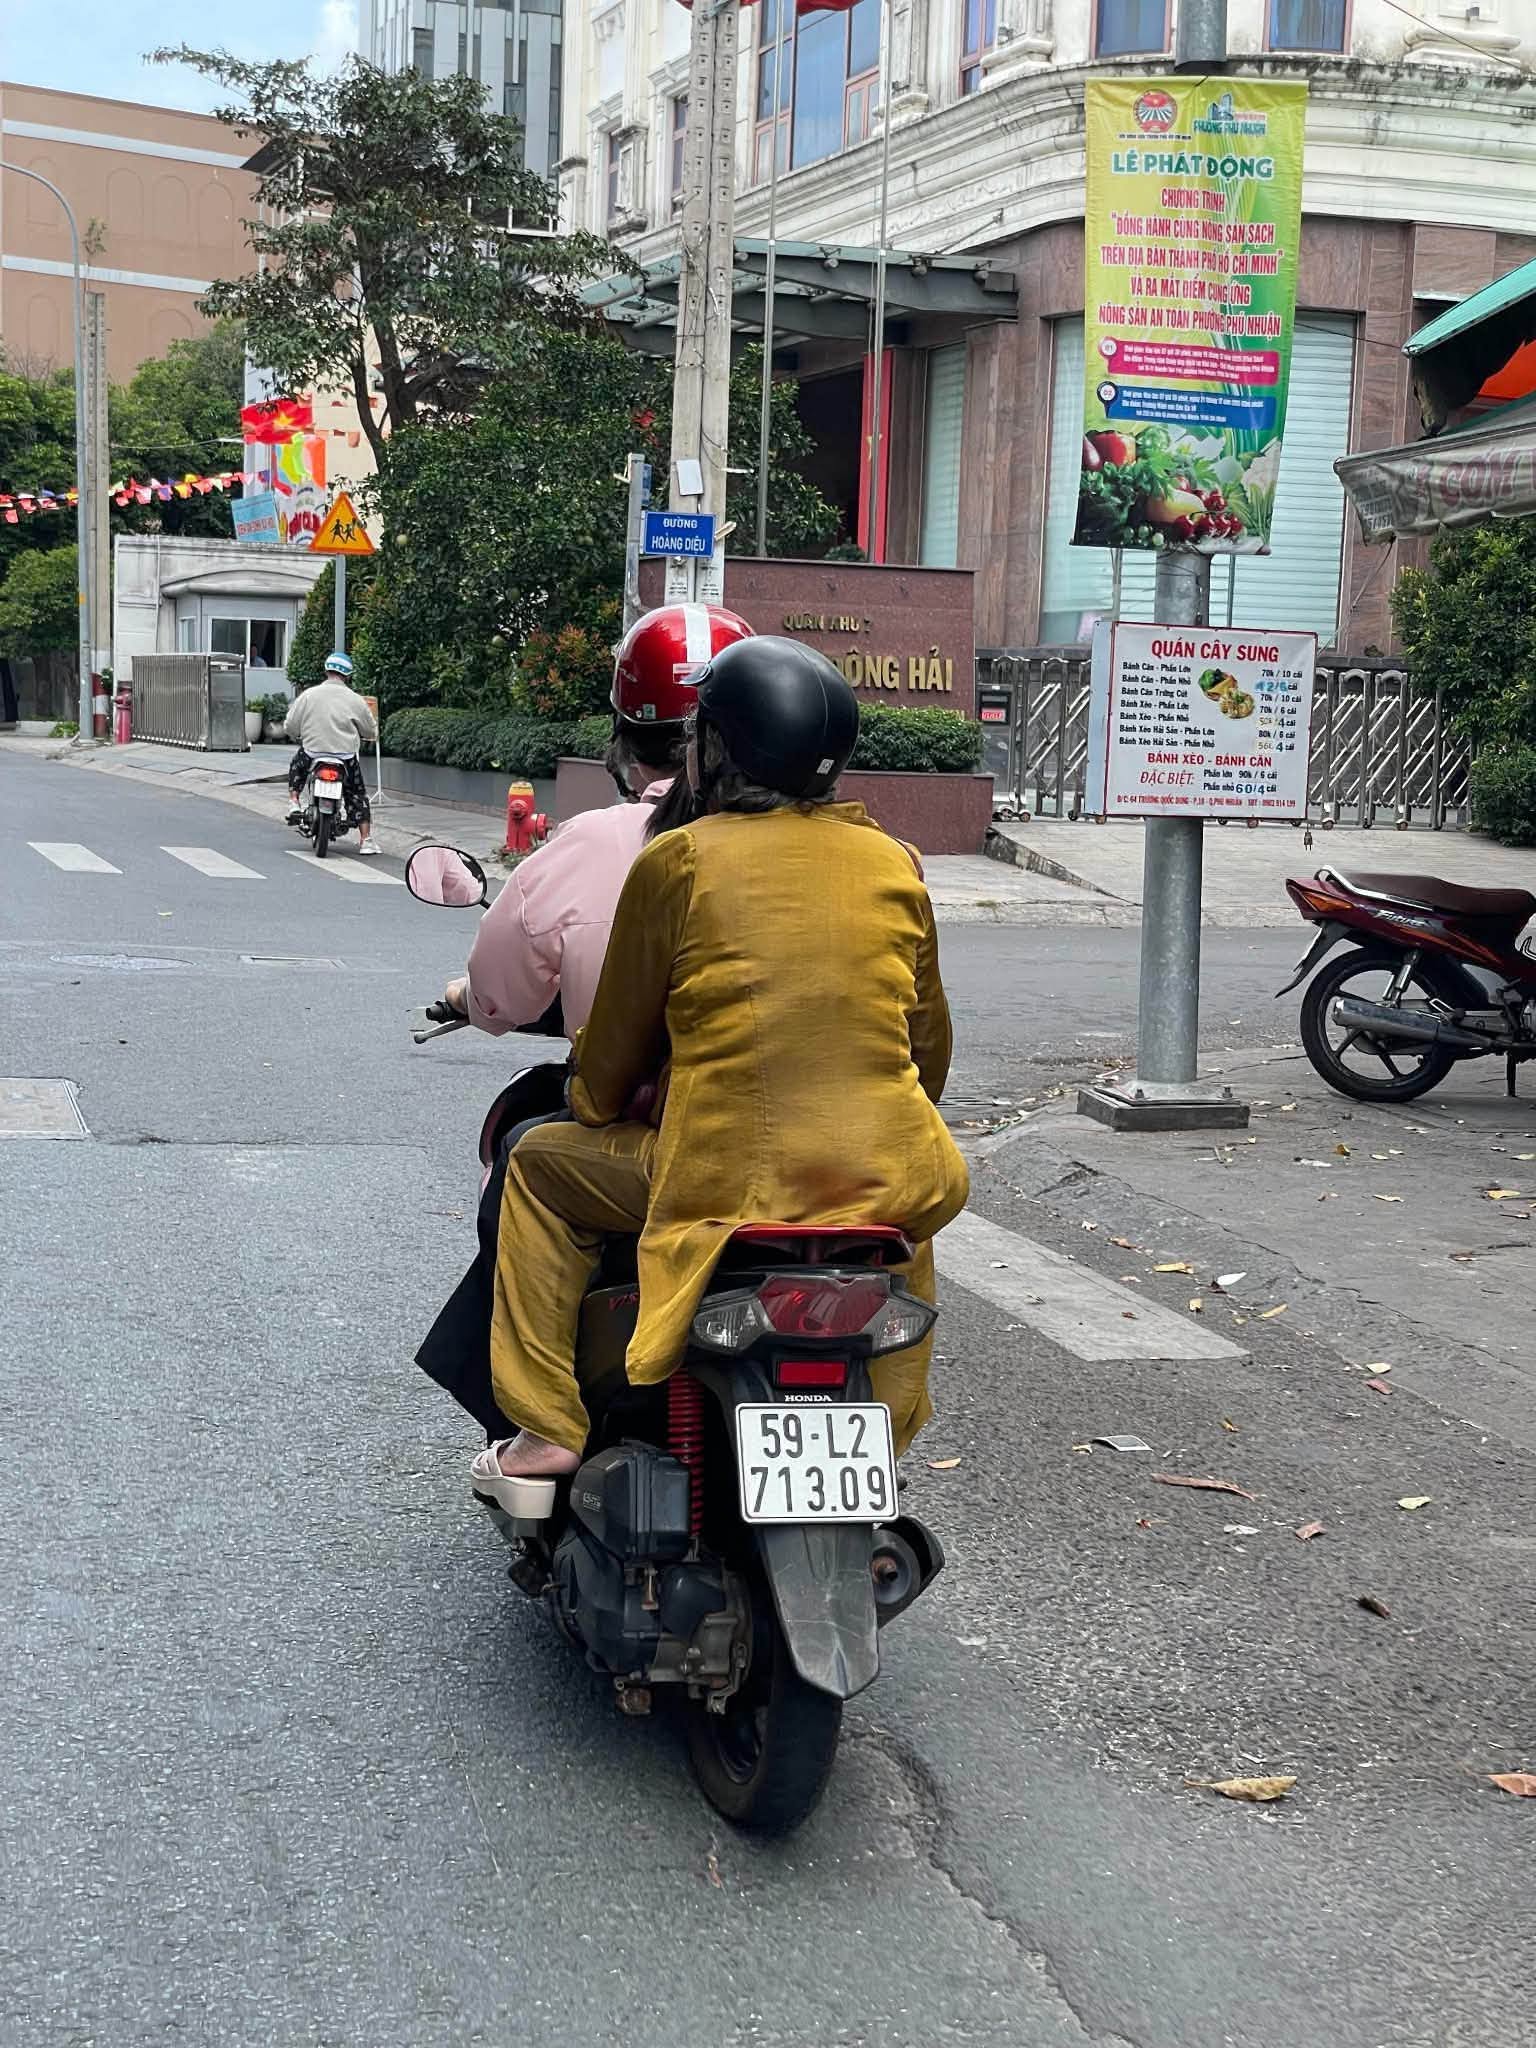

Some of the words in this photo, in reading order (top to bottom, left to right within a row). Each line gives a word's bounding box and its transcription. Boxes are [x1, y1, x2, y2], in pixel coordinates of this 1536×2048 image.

[1144, 152, 1203, 174] PHÁT
[1207, 155, 1273, 181] ĐỘNG
[1162, 187, 1199, 208] CHƯƠNG
[1146, 213, 1171, 237] HÀNH
[1174, 215, 1199, 239] CÙNG
[1248, 223, 1274, 248] SẠCH
[1101, 242, 1126, 265] TRÊN
[1128, 246, 1144, 269] ĐỊA
[1147, 244, 1166, 267] BÀN
[1169, 246, 1199, 269] THÀNH
[1131, 272, 1143, 295] VÀ
[1146, 277, 1158, 297] RA
[1161, 271, 1180, 298] MẮT
[1183, 272, 1206, 300] ĐIỂM
[1208, 281, 1228, 303] CUNG
[1230, 281, 1250, 304] ỨNG
[1099, 301, 1126, 325] NÔNG
[1128, 300, 1148, 326] SẢN
[1150, 308, 1163, 327] AN
[1166, 305, 1190, 328] TOÀN
[1193, 308, 1225, 333] PHƯỜNG
[1226, 312, 1246, 335] PHÚ
[1247, 311, 1281, 340] NHUẬN
[663, 516, 698, 529] ĐƯỜNG
[652, 533, 683, 550] HOÀNG
[685, 535, 706, 555] DIỆU
[783, 611, 825, 632] QUÂN
[1151, 636, 1195, 660] QUÁN
[1200, 639, 1232, 661] CÂY
[1236, 644, 1280, 663] SUNG
[908, 644, 953, 691] HẢI
[1122, 661, 1140, 670] Bánh
[1160, 663, 1177, 673] Phần
[1261, 669, 1274, 678] 70k
[1282, 670, 1292, 678] 10
[1293, 671, 1303, 679] cái
[1122, 674, 1140, 683] Bánh
[1178, 676, 1191, 686] Nhỏ
[1121, 686, 1139, 695] Bánh
[1155, 688, 1174, 698] Trứng
[1176, 689, 1188, 698] Cút
[1260, 693, 1273, 702] 70k
[1281, 694, 1291, 703] 10
[1291, 695, 1302, 703] cái
[1120, 699, 1138, 708] Bánh
[1139, 700, 1152, 709] Xèo
[1158, 700, 1175, 710] Phần
[1260, 705, 1273, 714] 70k
[1280, 706, 1286, 714] 6
[1286, 707, 1297, 715] cái
[1120, 711, 1137, 720] Bánh
[1138, 712, 1152, 721] Xèo
[1158, 713, 1175, 722] Phần
[1176, 713, 1190, 722] Nhỏ
[1286, 719, 1296, 727] cái
[1119, 724, 1137, 733] Bánh
[1138, 725, 1152, 734] Xèo
[1153, 725, 1164, 735] Hải
[1184, 726, 1201, 736] Phần
[1258, 729, 1271, 738] 80k
[1279, 730, 1284, 738] 6
[1285, 731, 1296, 739] cái
[1119, 736, 1137, 745] Bánh
[1138, 737, 1151, 746] Xèo
[1152, 737, 1164, 746] Hải
[1184, 738, 1201, 748] Phần
[1202, 738, 1216, 748] Nhỏ
[1275, 741, 1283, 752] 4
[1147, 750, 1179, 764] BÁNH
[1182, 751, 1205, 765] XÈO
[1215, 752, 1246, 767] BÁNH
[1140, 768, 1166, 787] ĐẶC
[1203, 768, 1220, 778] Phần
[1238, 770, 1252, 779] 90k
[1267, 771, 1278, 780] cái
[1203, 781, 1220, 791] Phần
[1222, 783, 1235, 792] nhỏ
[1266, 784, 1277, 793] cái
[1373, 909, 1426, 927] Future
[784, 1394, 833, 1402] HONDA
[760, 1413, 869, 1459] 59-L2
[750, 1466, 888, 1513] 713.09
